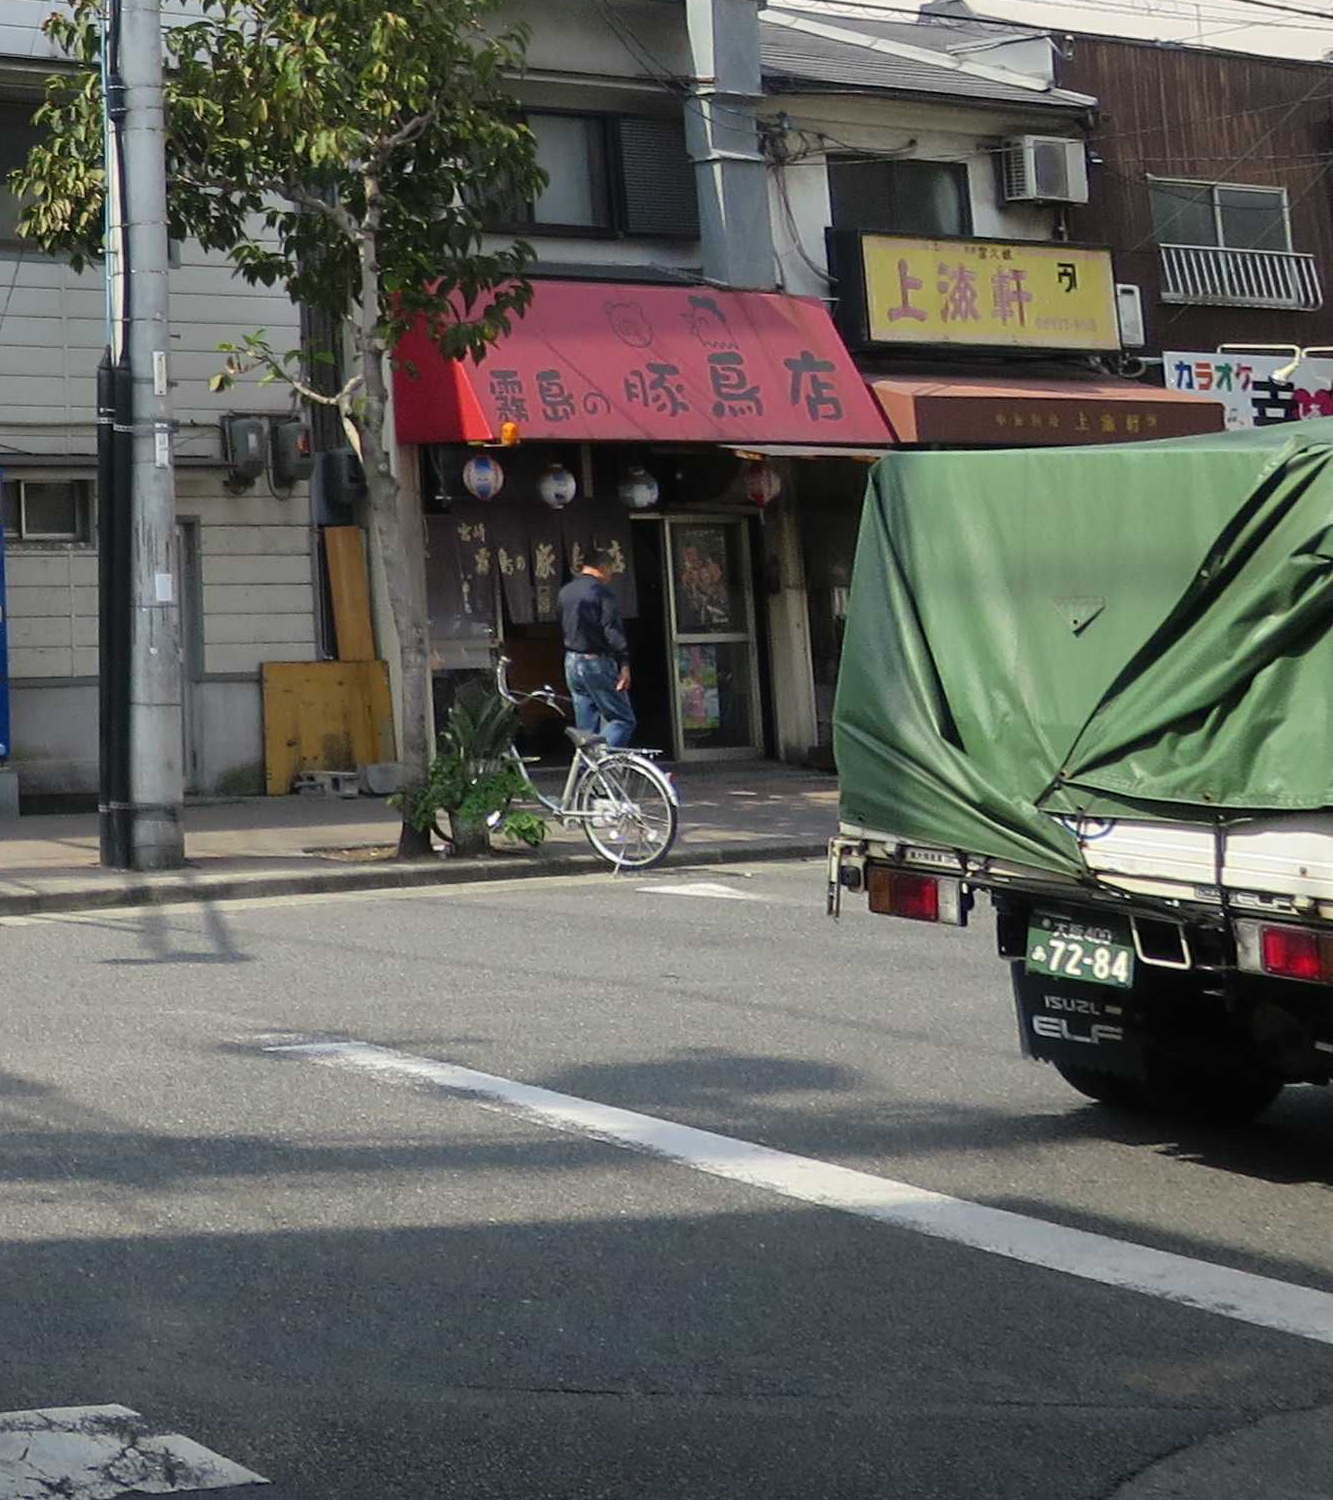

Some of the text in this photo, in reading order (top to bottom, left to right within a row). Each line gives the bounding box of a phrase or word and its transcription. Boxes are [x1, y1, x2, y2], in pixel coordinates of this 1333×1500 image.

[488, 350, 845, 423] 霧島の豚鳥店
[1173, 359, 1254, 392] カラオケ
[1049, 939, 1129, 982] 72-84
[1033, 1015, 1124, 1044] ELF
